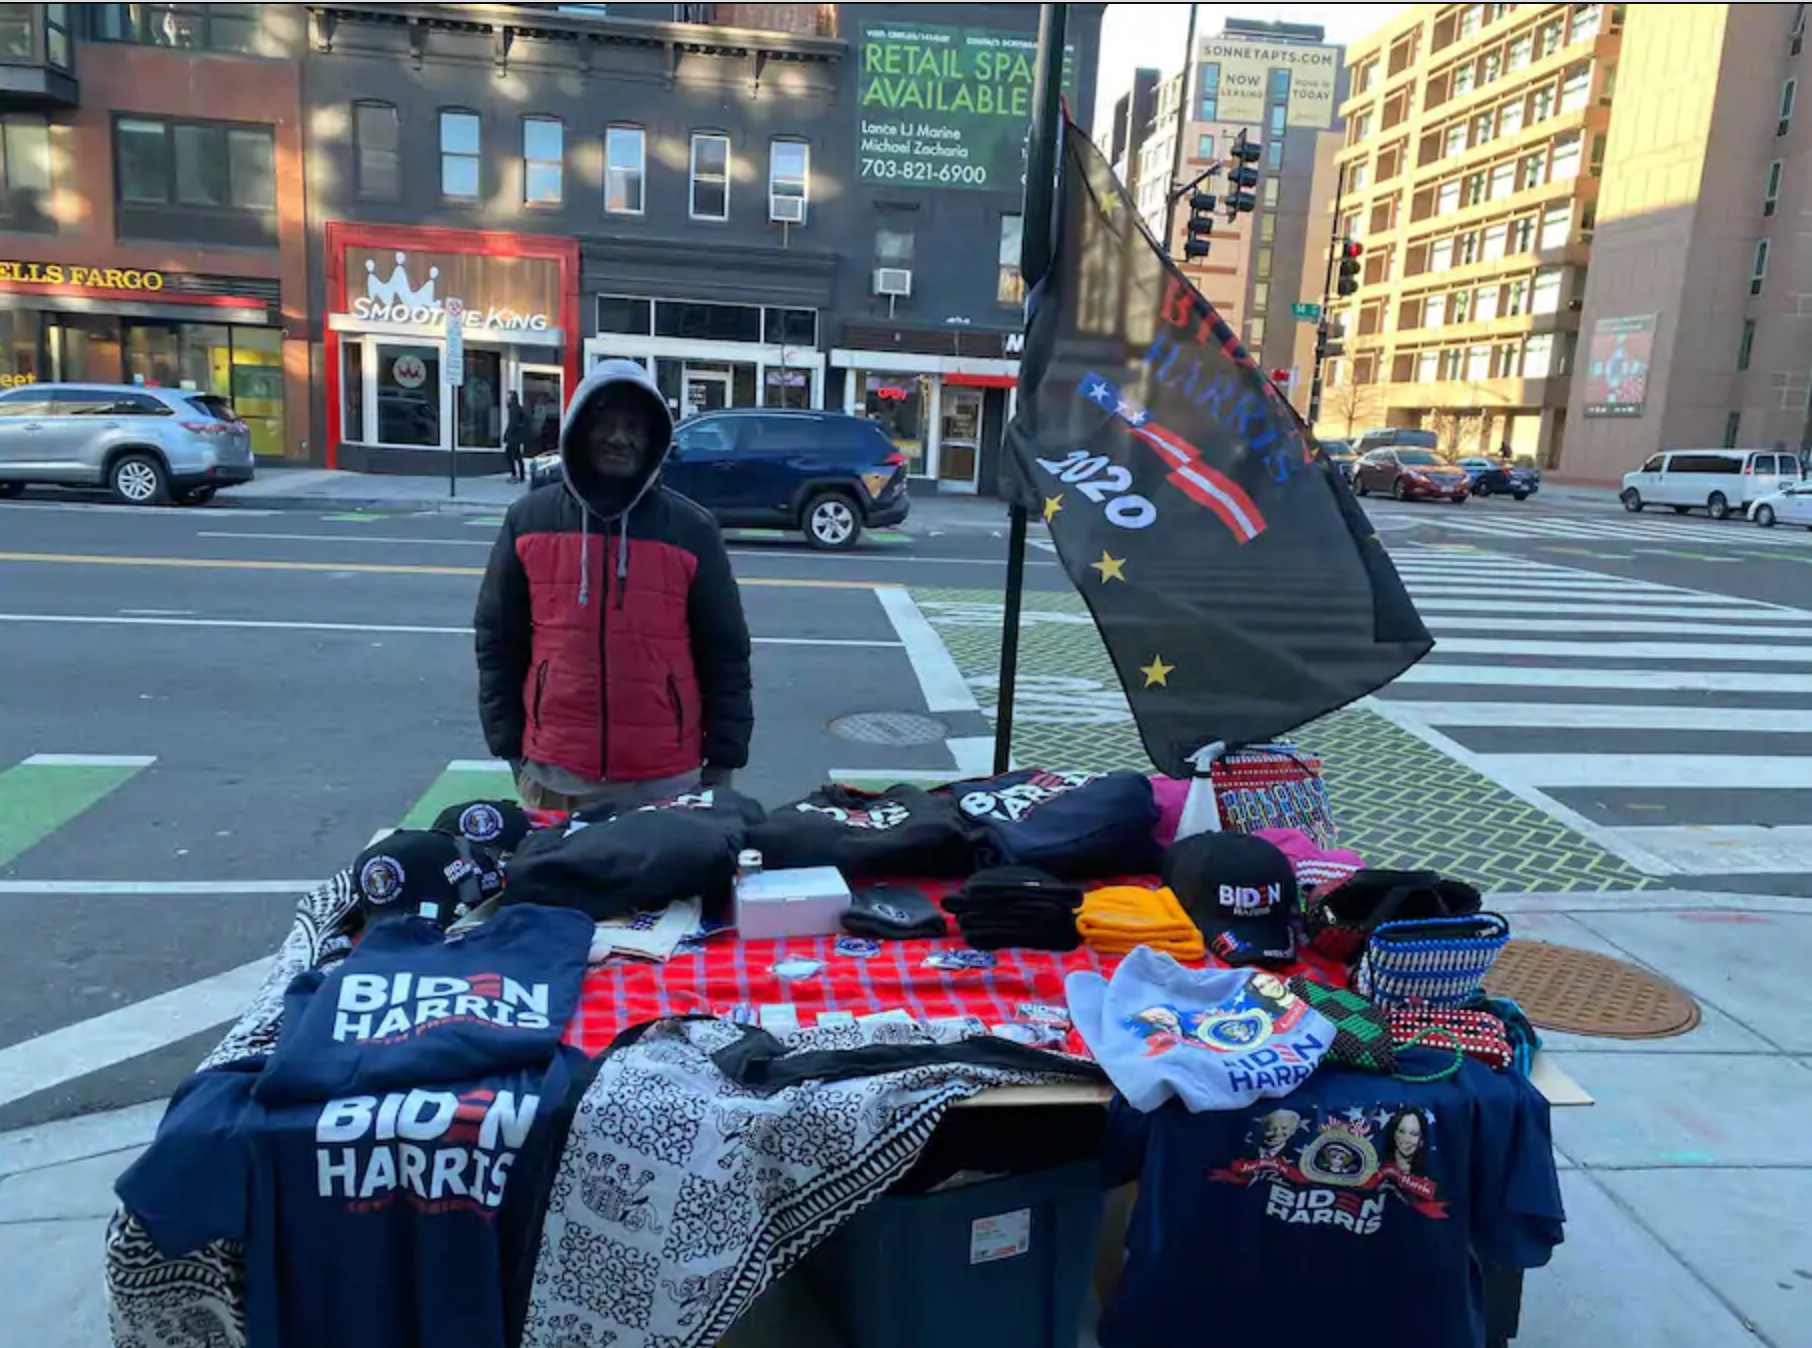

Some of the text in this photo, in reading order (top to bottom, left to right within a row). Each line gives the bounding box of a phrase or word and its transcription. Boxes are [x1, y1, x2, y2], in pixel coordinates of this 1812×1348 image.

[864, 43, 964, 79] RETAIL
[974, 51, 1038, 84] SPA
[1203, 45, 1333, 67] SONNETAPTS.COM
[1226, 74, 1261, 87] NOW
[1292, 90, 1331, 100] TODAY
[862, 77, 1028, 116] AVAILABLE
[861, 120, 898, 136] Lance
[916, 125, 961, 141] Marine
[861, 139, 911, 154] Michael
[861, 158, 987, 185] 703-821-6900
[69, 266, 164, 291] FARGO
[1219, 882, 1281, 908] BIDEN
[338, 972, 549, 1015] BIDEN
[332, 995, 551, 1042] HARRIS
[316, 1088, 541, 1150] BIDEN
[317, 1142, 518, 1208] HARRIS
[1270, 1184, 1387, 1219] BIDEN
[1265, 1202, 1383, 1235] HARRIS
